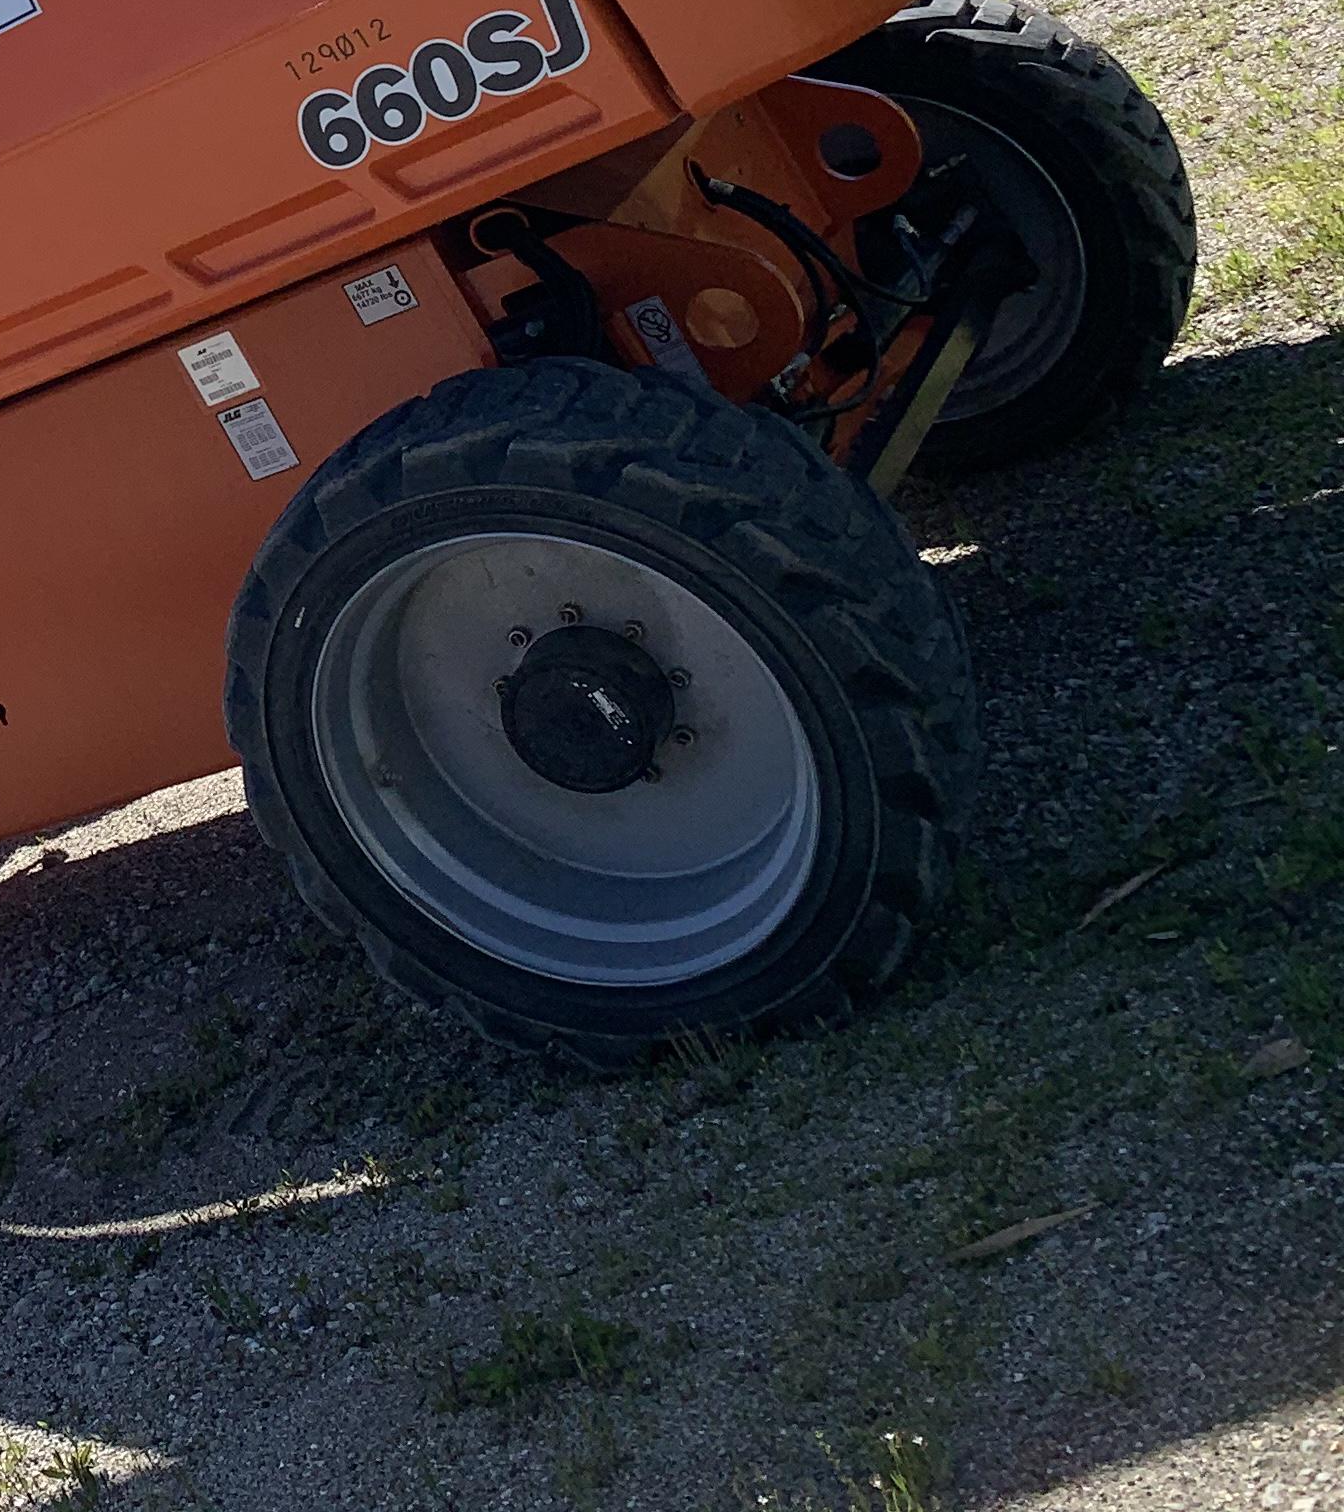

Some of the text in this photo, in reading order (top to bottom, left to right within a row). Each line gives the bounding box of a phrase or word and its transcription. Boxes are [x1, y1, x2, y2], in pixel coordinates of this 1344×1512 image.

[284, 18, 392, 81] 129012
[354, 279, 374, 291] MAX
[223, 409, 242, 423] JLG
